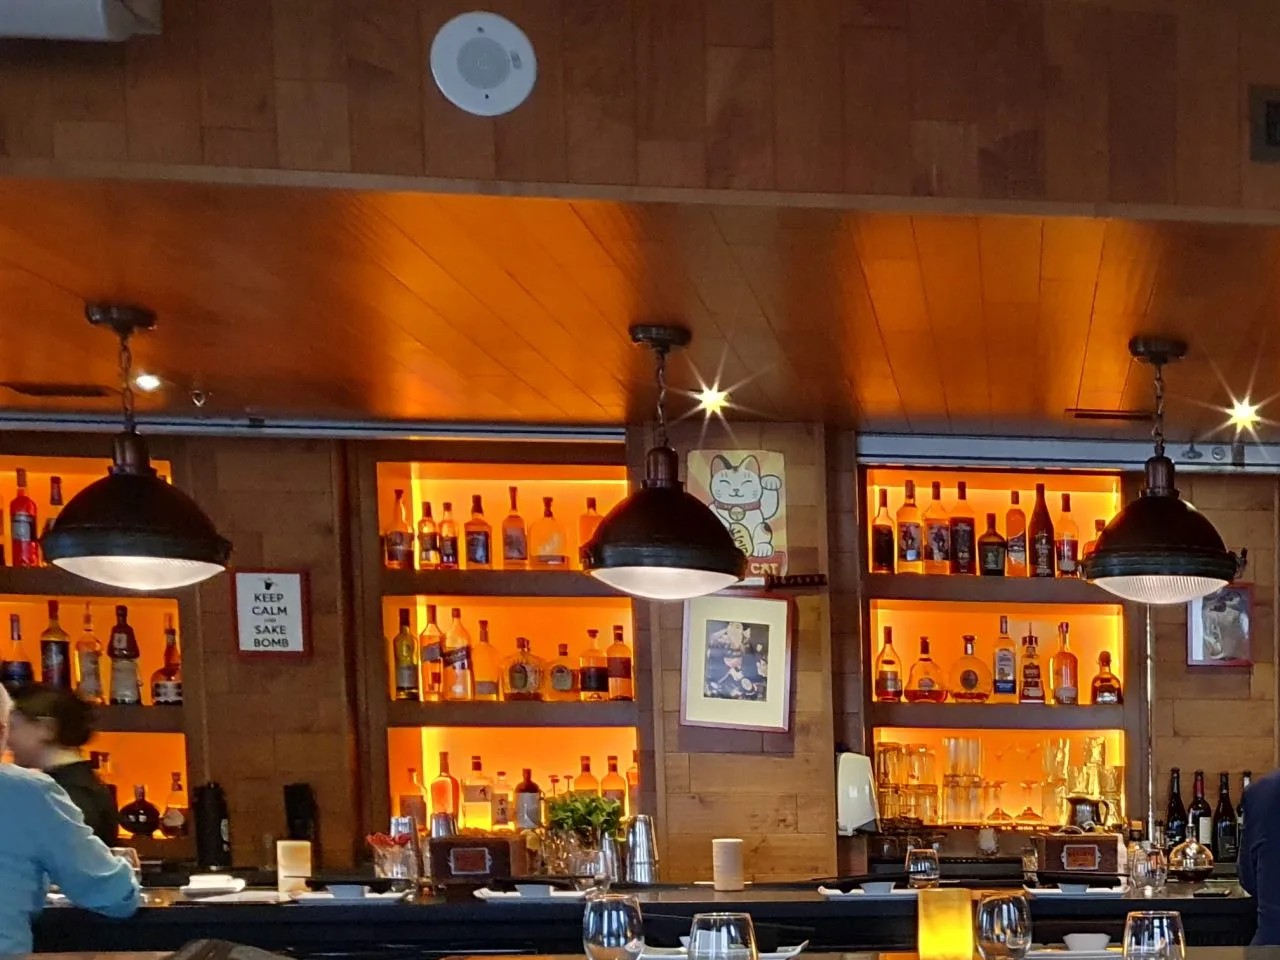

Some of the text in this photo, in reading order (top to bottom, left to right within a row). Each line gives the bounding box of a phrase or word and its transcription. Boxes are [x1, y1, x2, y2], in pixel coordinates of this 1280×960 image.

[750, 562, 779, 575] CAT
[254, 593, 284, 602] KEEP
[252, 606, 288, 616] CALM
[254, 625, 287, 635] SAKE
[253, 638, 289, 648] BOMB
